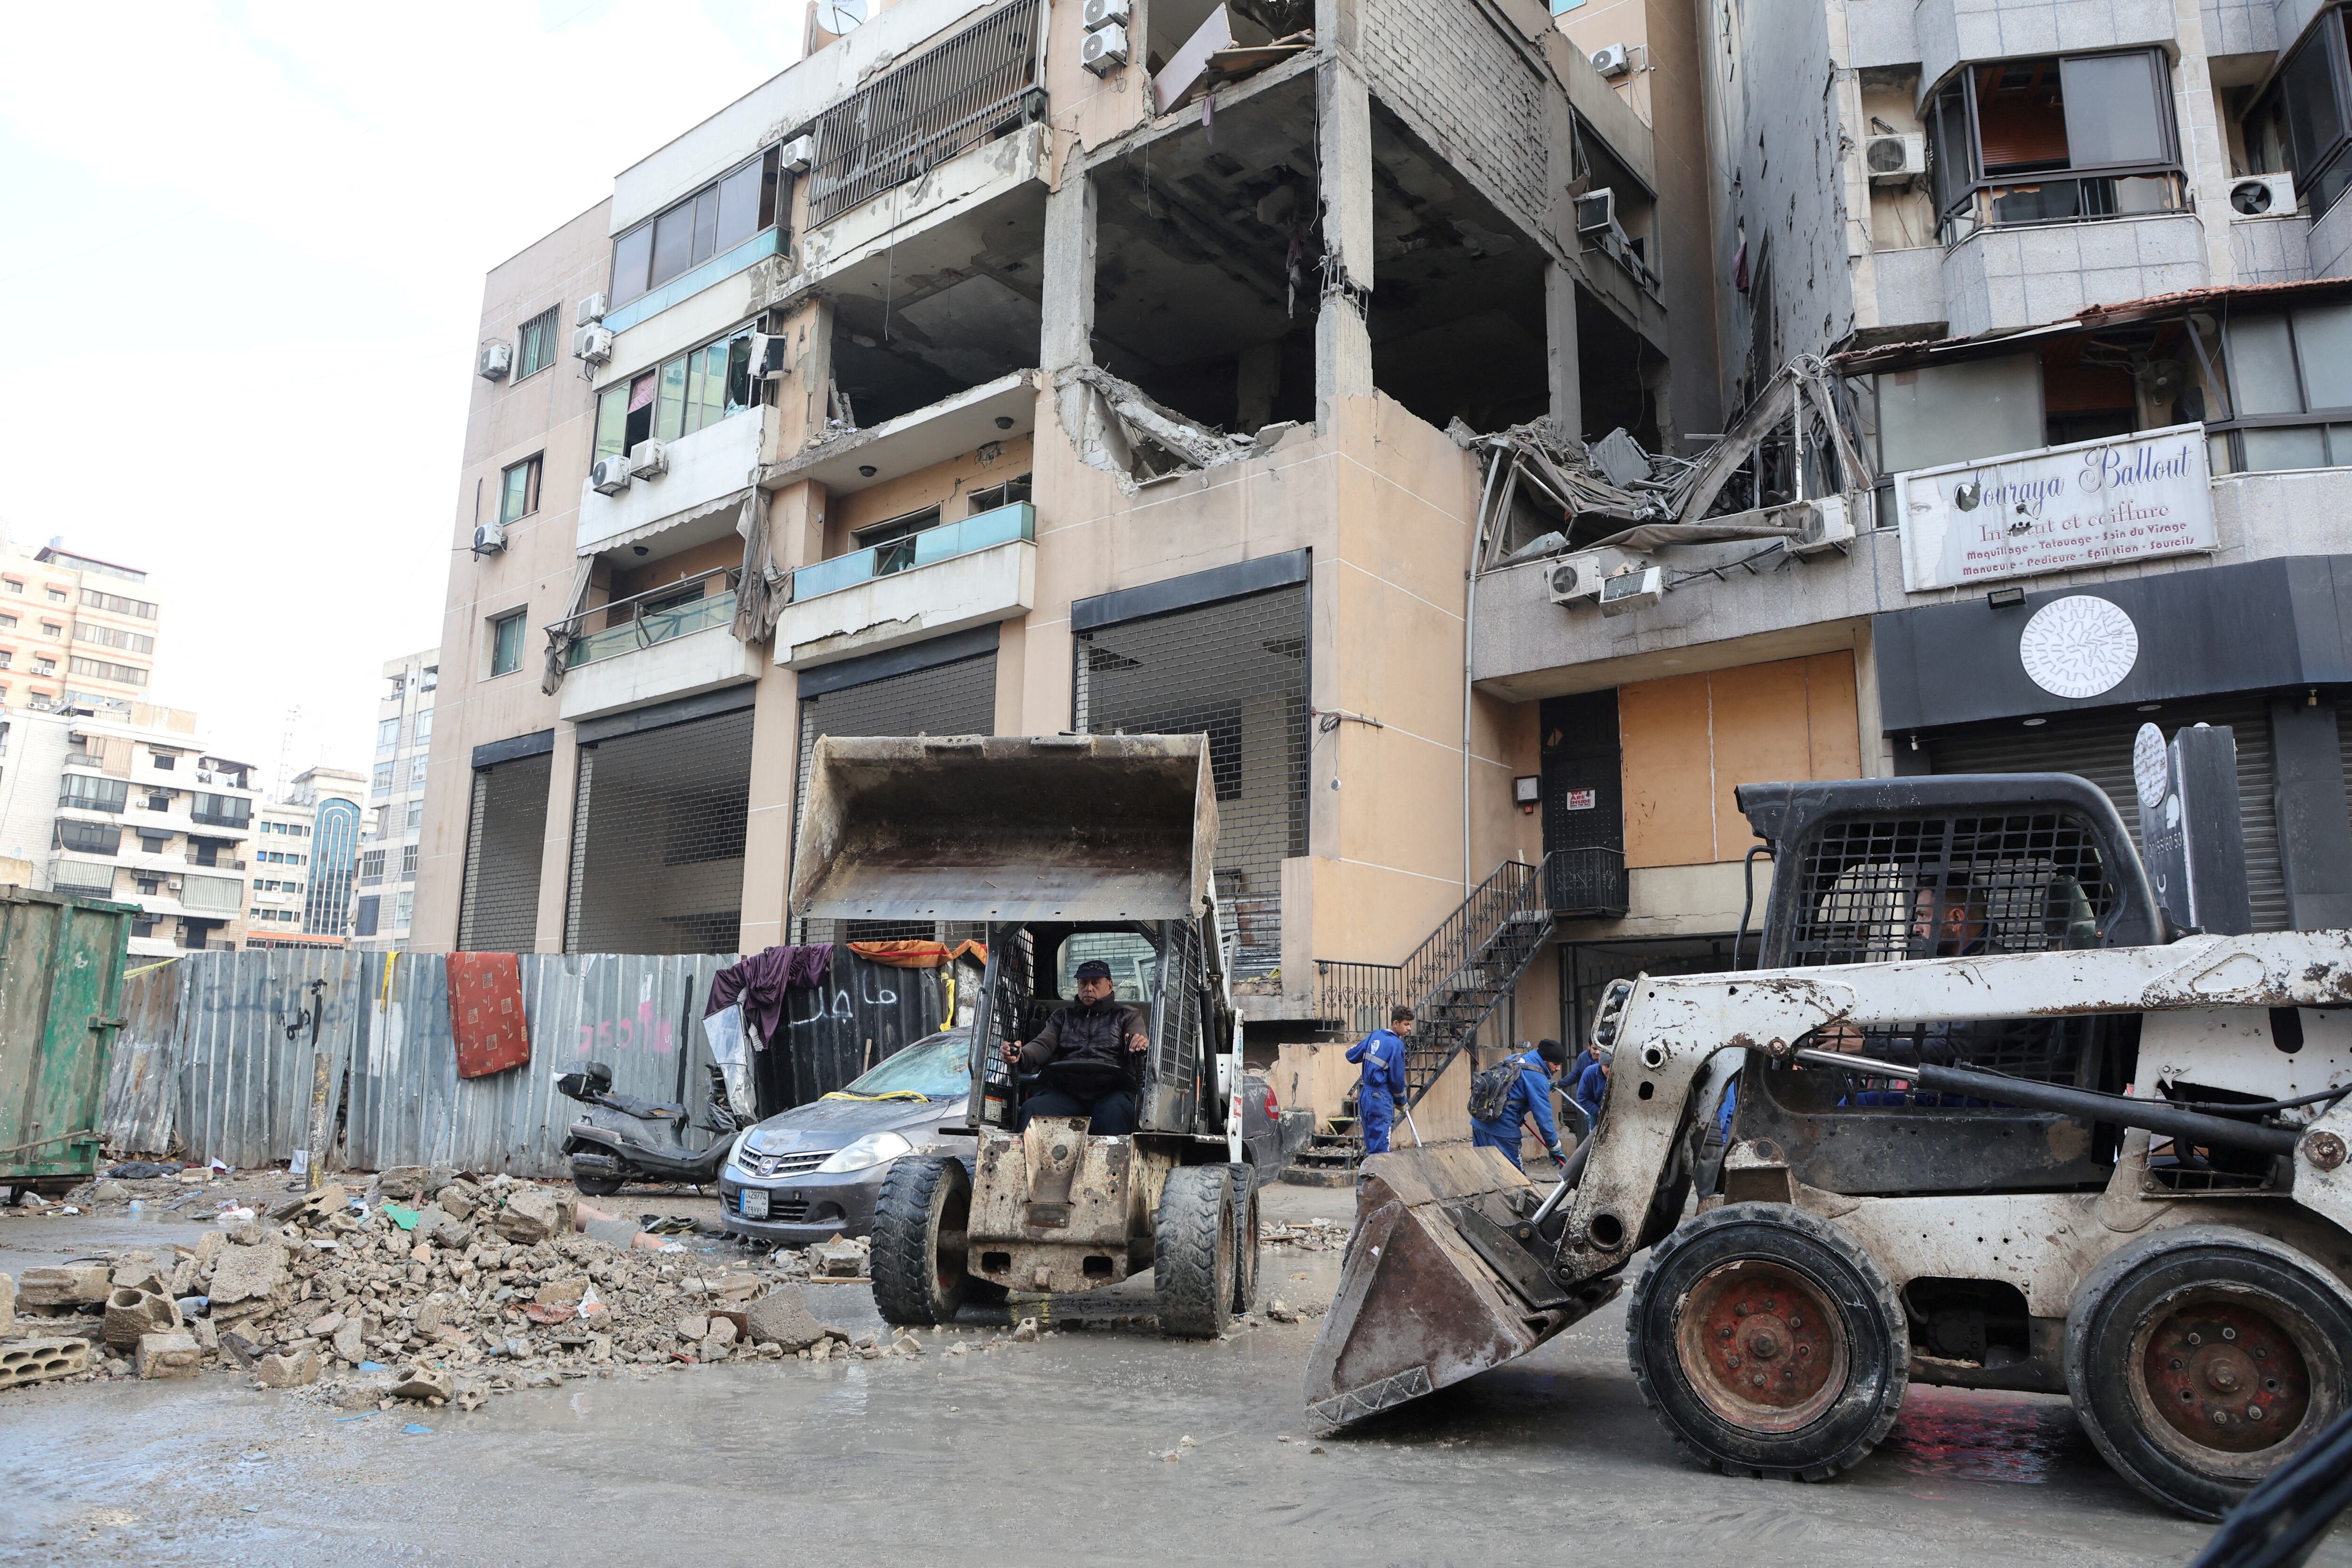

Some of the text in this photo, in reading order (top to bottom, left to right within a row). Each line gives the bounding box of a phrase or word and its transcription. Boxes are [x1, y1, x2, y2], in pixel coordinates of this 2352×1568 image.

[2079, 445, 2193, 493] Ballout
[1979, 500, 2169, 542] Inut et coiffure
[1967, 545, 2029, 560] Maquillage
[2039, 537, 2092, 549] Tatouage
[2103, 530, 2126, 541] Soin
[2130, 527, 2144, 537] du
[2147, 523, 2187, 533] Visage
[2027, 554, 2076, 566] Pedicure
[2150, 536, 2194, 549] Sourcils
